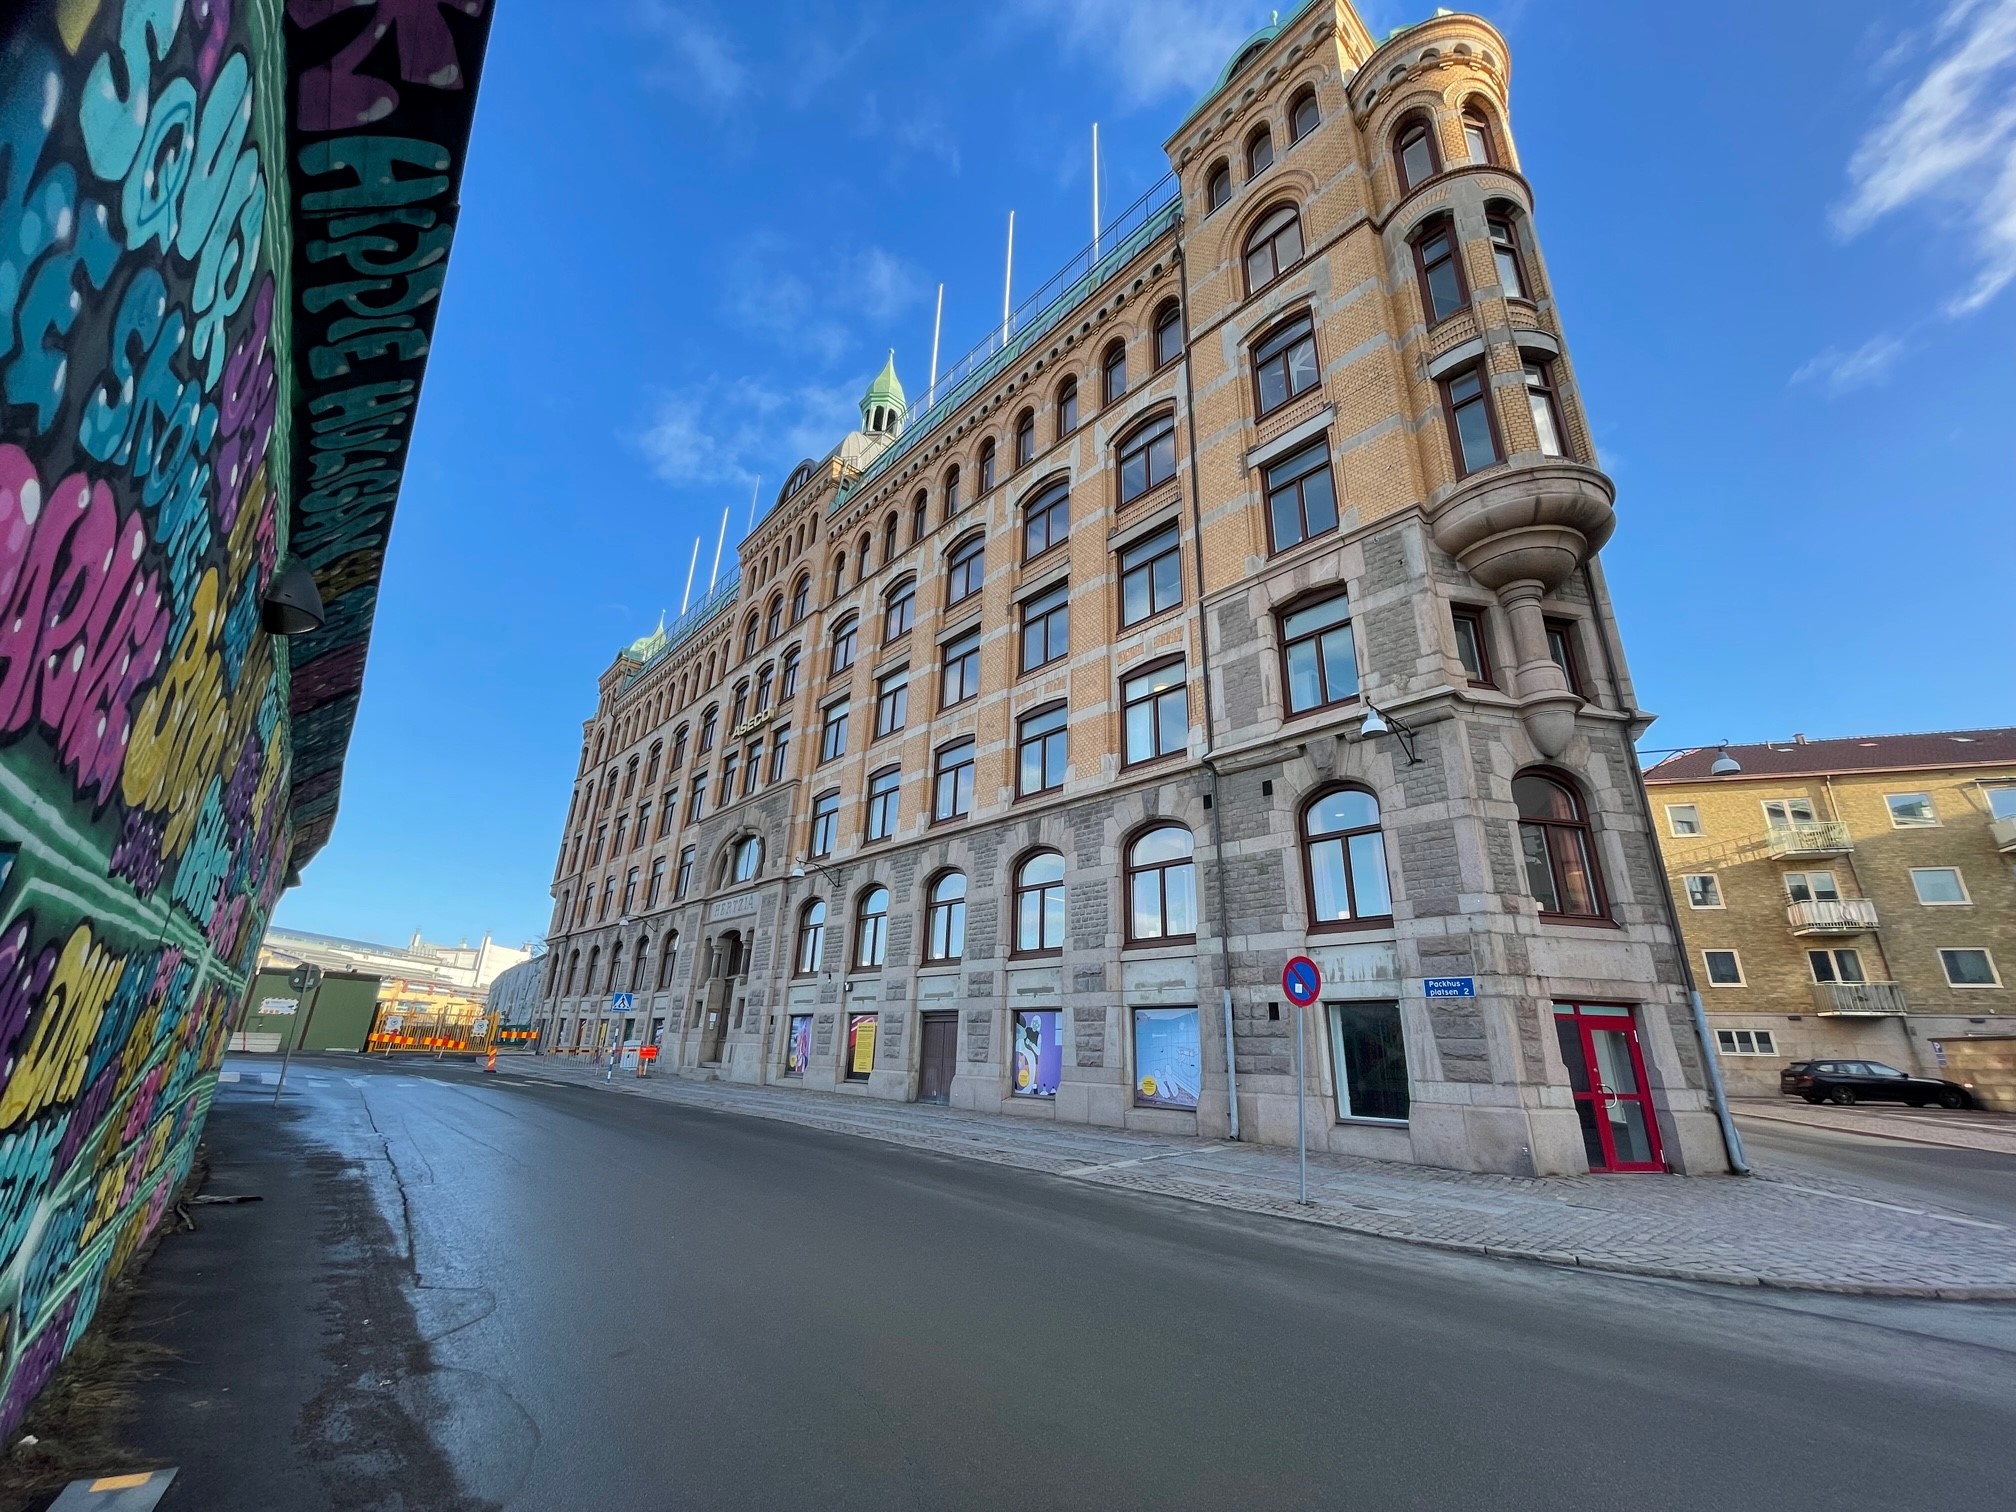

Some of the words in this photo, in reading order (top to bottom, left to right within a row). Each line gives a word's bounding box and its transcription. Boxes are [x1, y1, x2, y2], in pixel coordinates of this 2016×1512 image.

[299, 136, 452, 382] HIPPIE
[296, 379, 413, 562] HULIGAN
[122, 566, 230, 861] BINGO
[731, 708, 770, 740] ASECO
[714, 894, 754, 917] HERTZIA
[1428, 980, 1465, 988] Packhus-
[1463, 987, 1470, 995] 2
